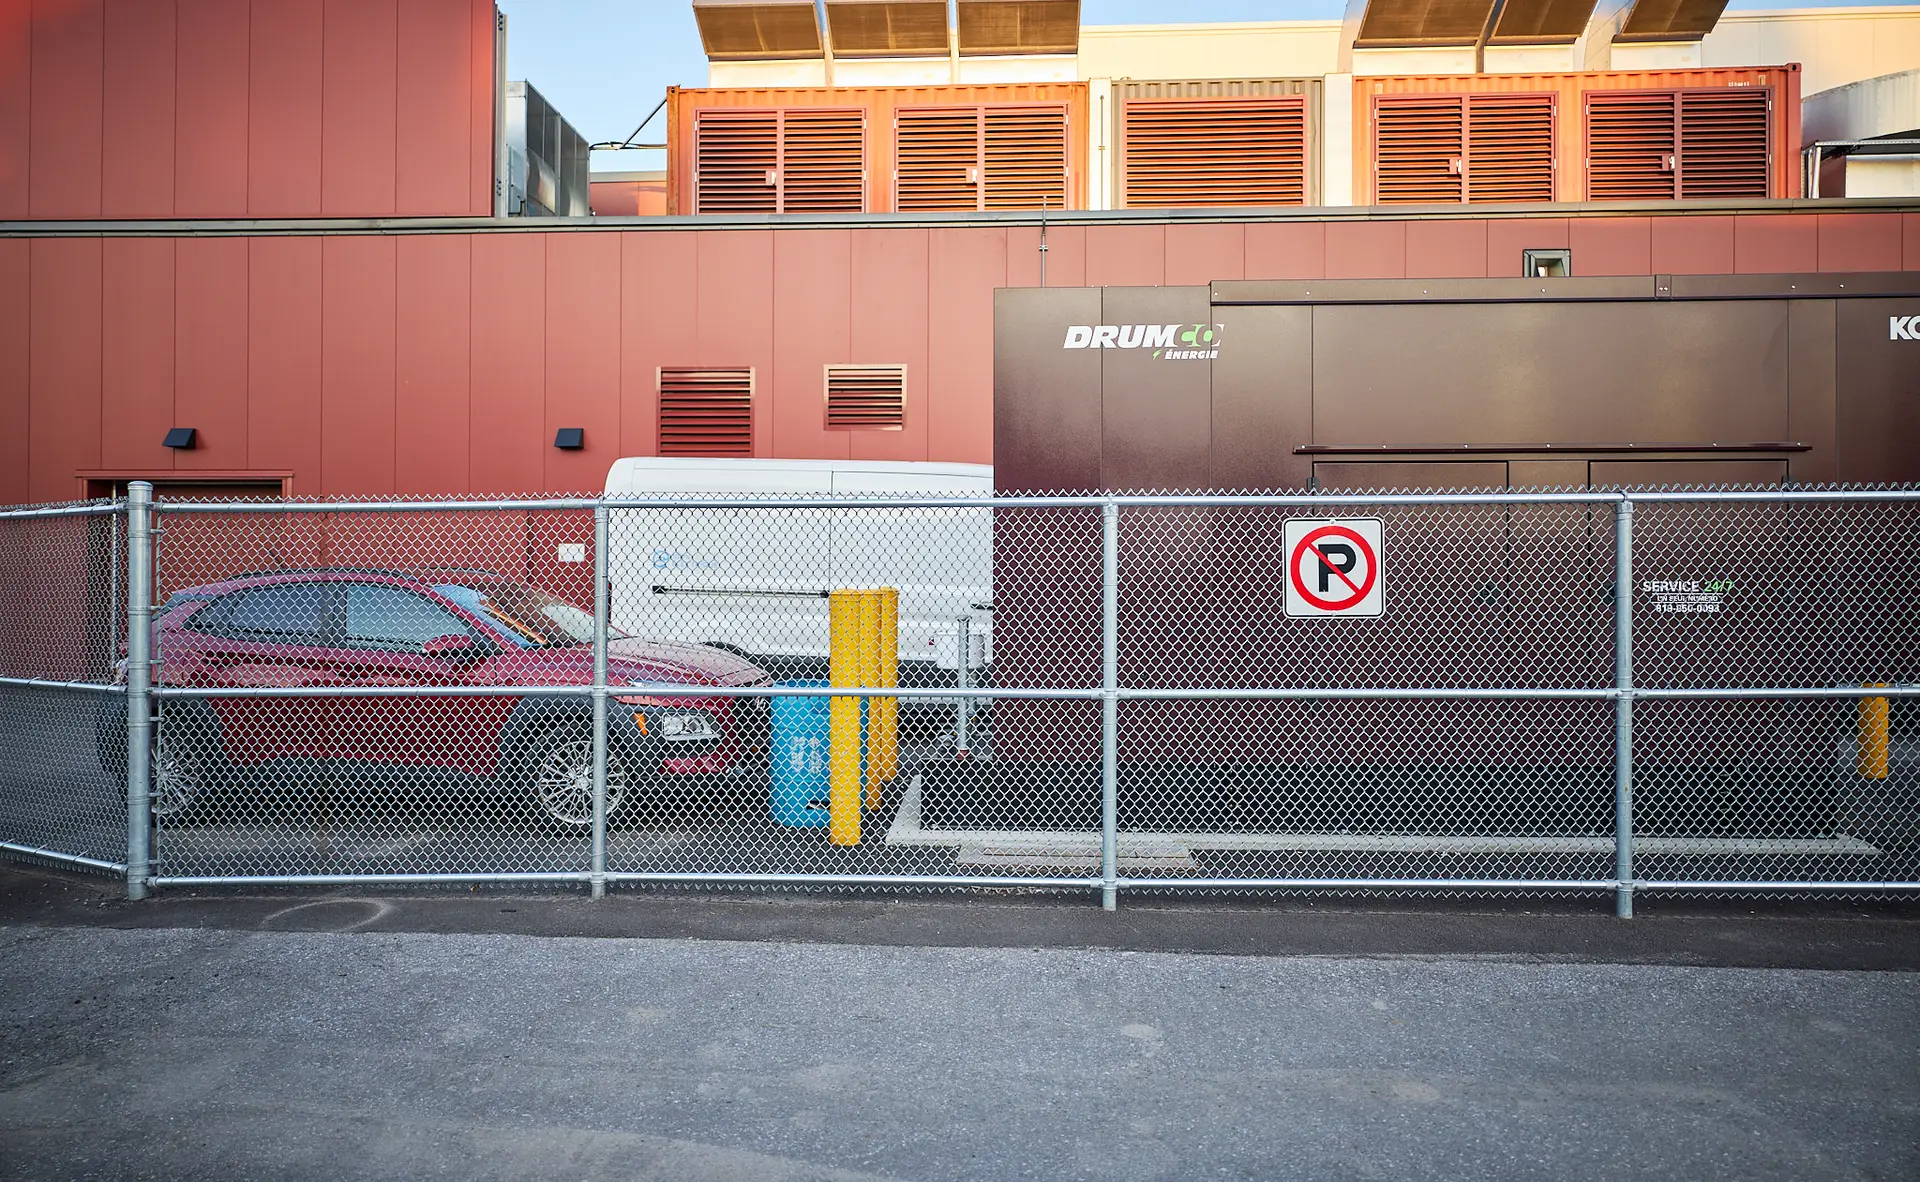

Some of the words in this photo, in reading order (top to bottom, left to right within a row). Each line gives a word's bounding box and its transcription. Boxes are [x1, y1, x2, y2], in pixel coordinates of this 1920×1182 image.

[1063, 324, 1225, 349] DRUMCO
[1164, 349, 1219, 360] ÉNERGIE
[1318, 543, 1357, 592] P
[1643, 580, 1700, 592] SERVICE
[1704, 580, 1733, 592] 24/7
